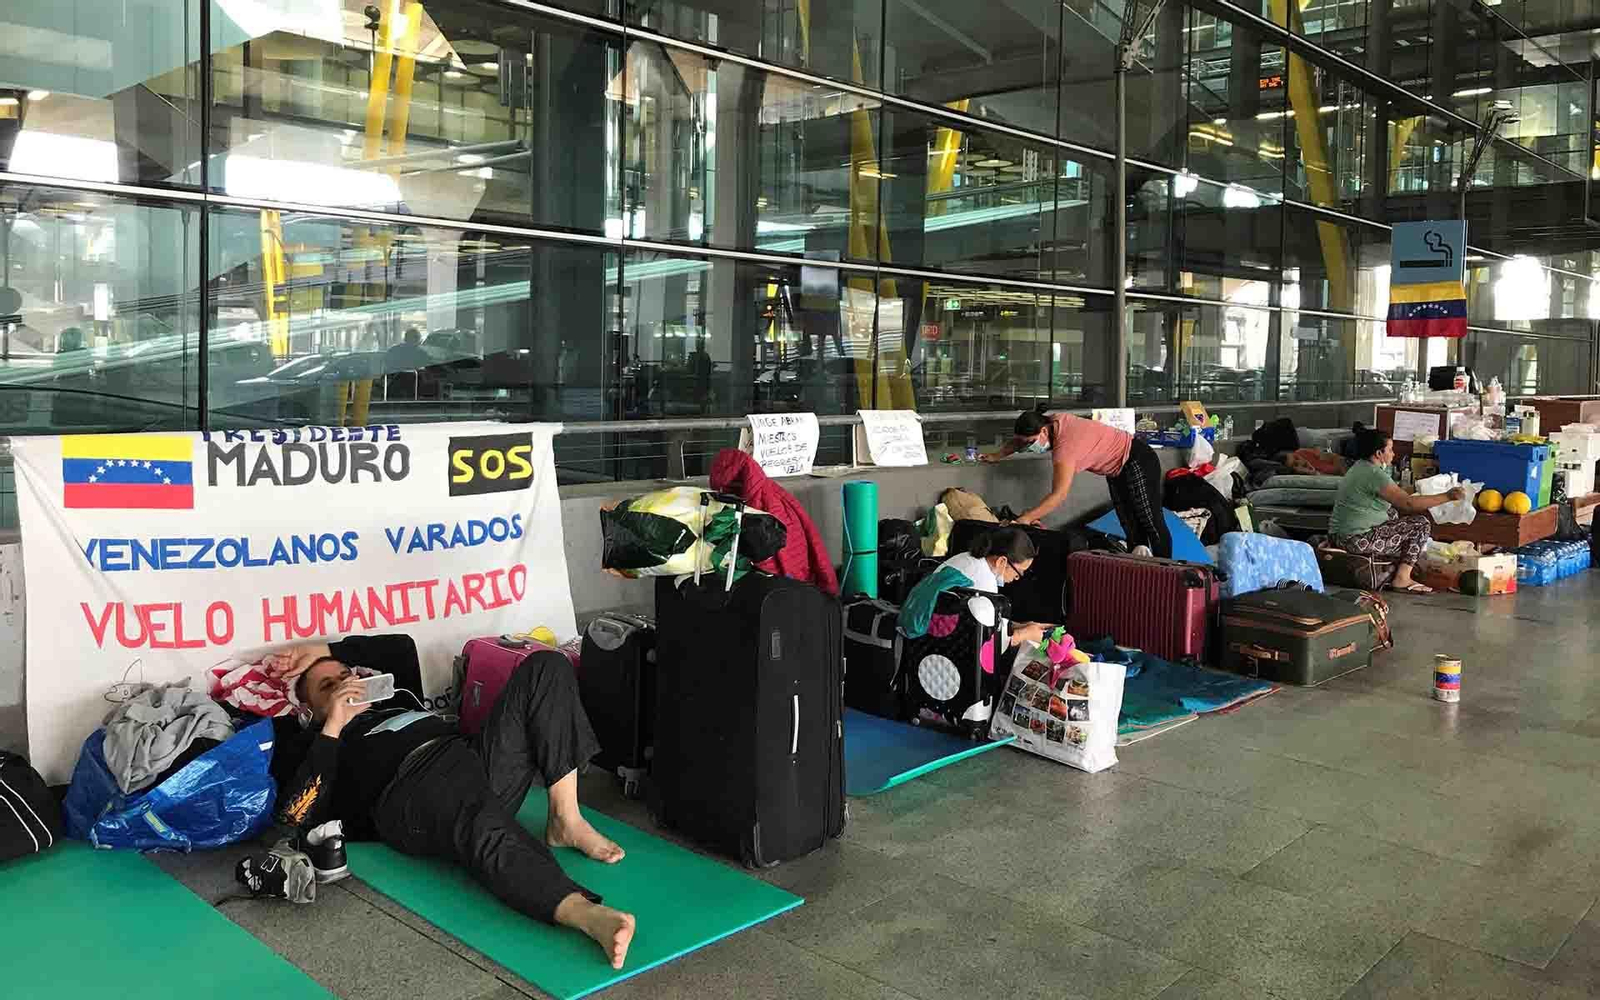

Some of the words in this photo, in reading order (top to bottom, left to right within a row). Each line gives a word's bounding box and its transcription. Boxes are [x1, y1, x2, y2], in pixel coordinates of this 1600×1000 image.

[207, 442, 411, 486] MADURO
[452, 443, 534, 482] SOS
[386, 515, 523, 553] VARADOS
[81, 601, 235, 649] VUELO
[262, 564, 528, 643] HUMANITARIO
